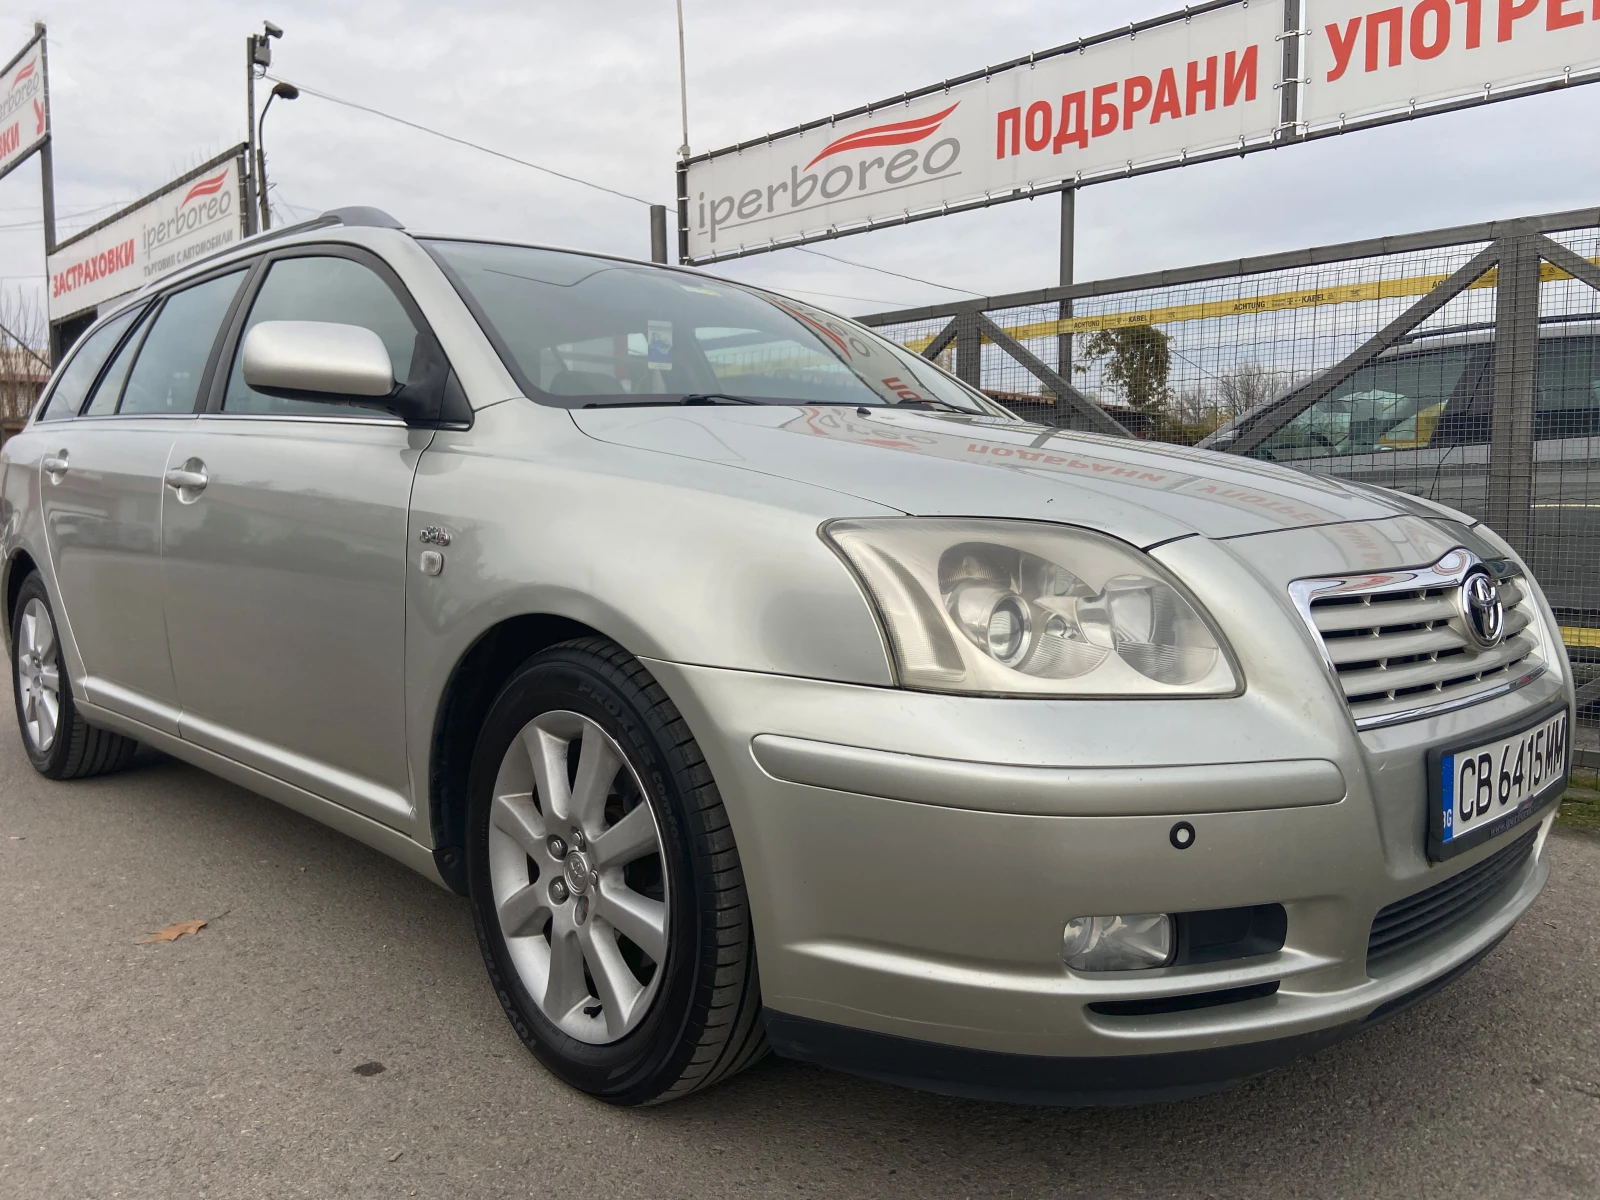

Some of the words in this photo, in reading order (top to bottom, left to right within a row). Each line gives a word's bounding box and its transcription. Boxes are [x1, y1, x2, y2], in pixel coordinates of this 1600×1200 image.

[996, 44, 1259, 160] ПОДБРАНИ
[1326, 0, 1600, 82] УПОТРЕ
[699, 137, 961, 243] iperboreo
[143, 190, 231, 260] iperboreo
[183, 229, 233, 262] АВТОМОБИЛИ
[53, 238, 135, 298] ЗАСТРАХОВКИ
[1073, 320, 1100, 329] ACHTUNG
[1128, 314, 1148, 323] KABEL
[1233, 301, 1265, 311] ACHTUNG
[1301, 294, 1325, 303] KABEL
[1460, 752, 1492, 822] CB
[1498, 729, 1544, 806] 6415
[499, 990, 537, 1050] TOYO
